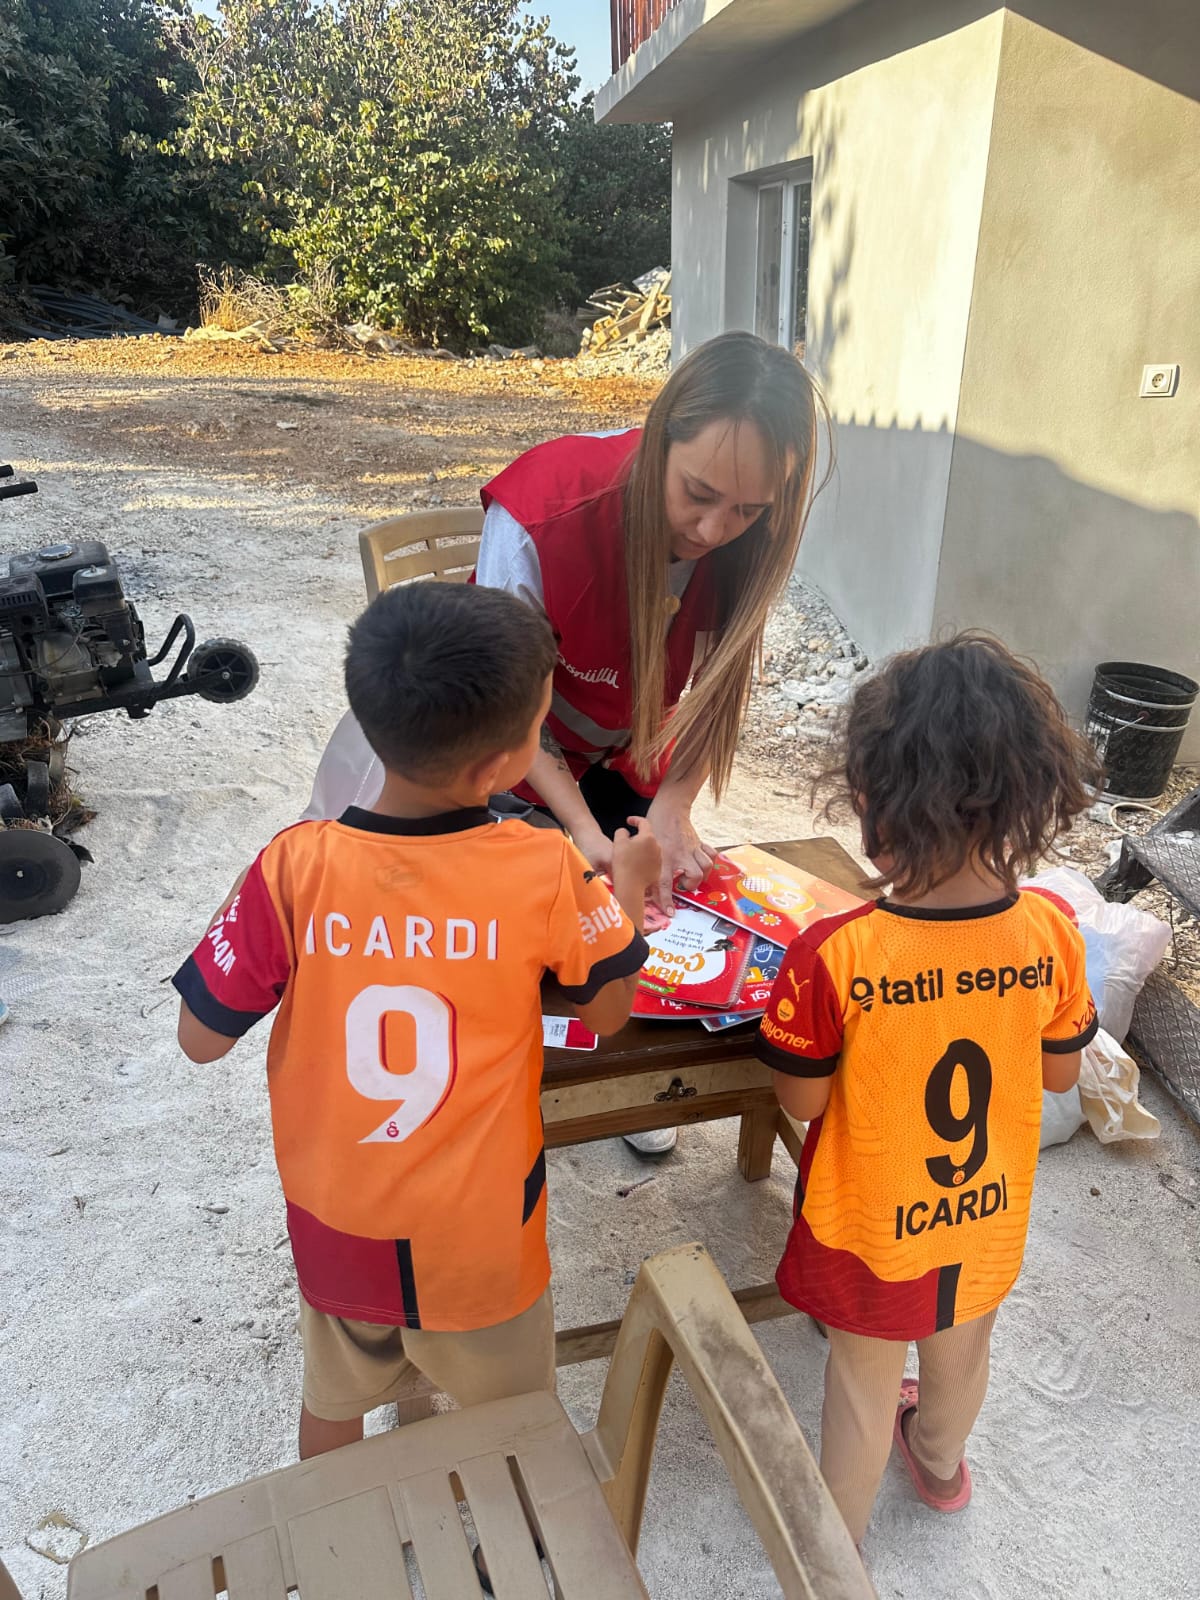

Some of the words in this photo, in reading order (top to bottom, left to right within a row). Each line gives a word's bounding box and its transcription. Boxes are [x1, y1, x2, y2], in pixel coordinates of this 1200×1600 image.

[306, 912, 499, 961] ICARDI
[878, 968, 944, 1006] tatil
[956, 956, 1054, 999] sepeti
[760, 1012, 814, 1050] Bilyoner
[345, 984, 458, 1143] 9
[924, 1038, 993, 1188] 9
[895, 1173, 1009, 1240] ICARDI
